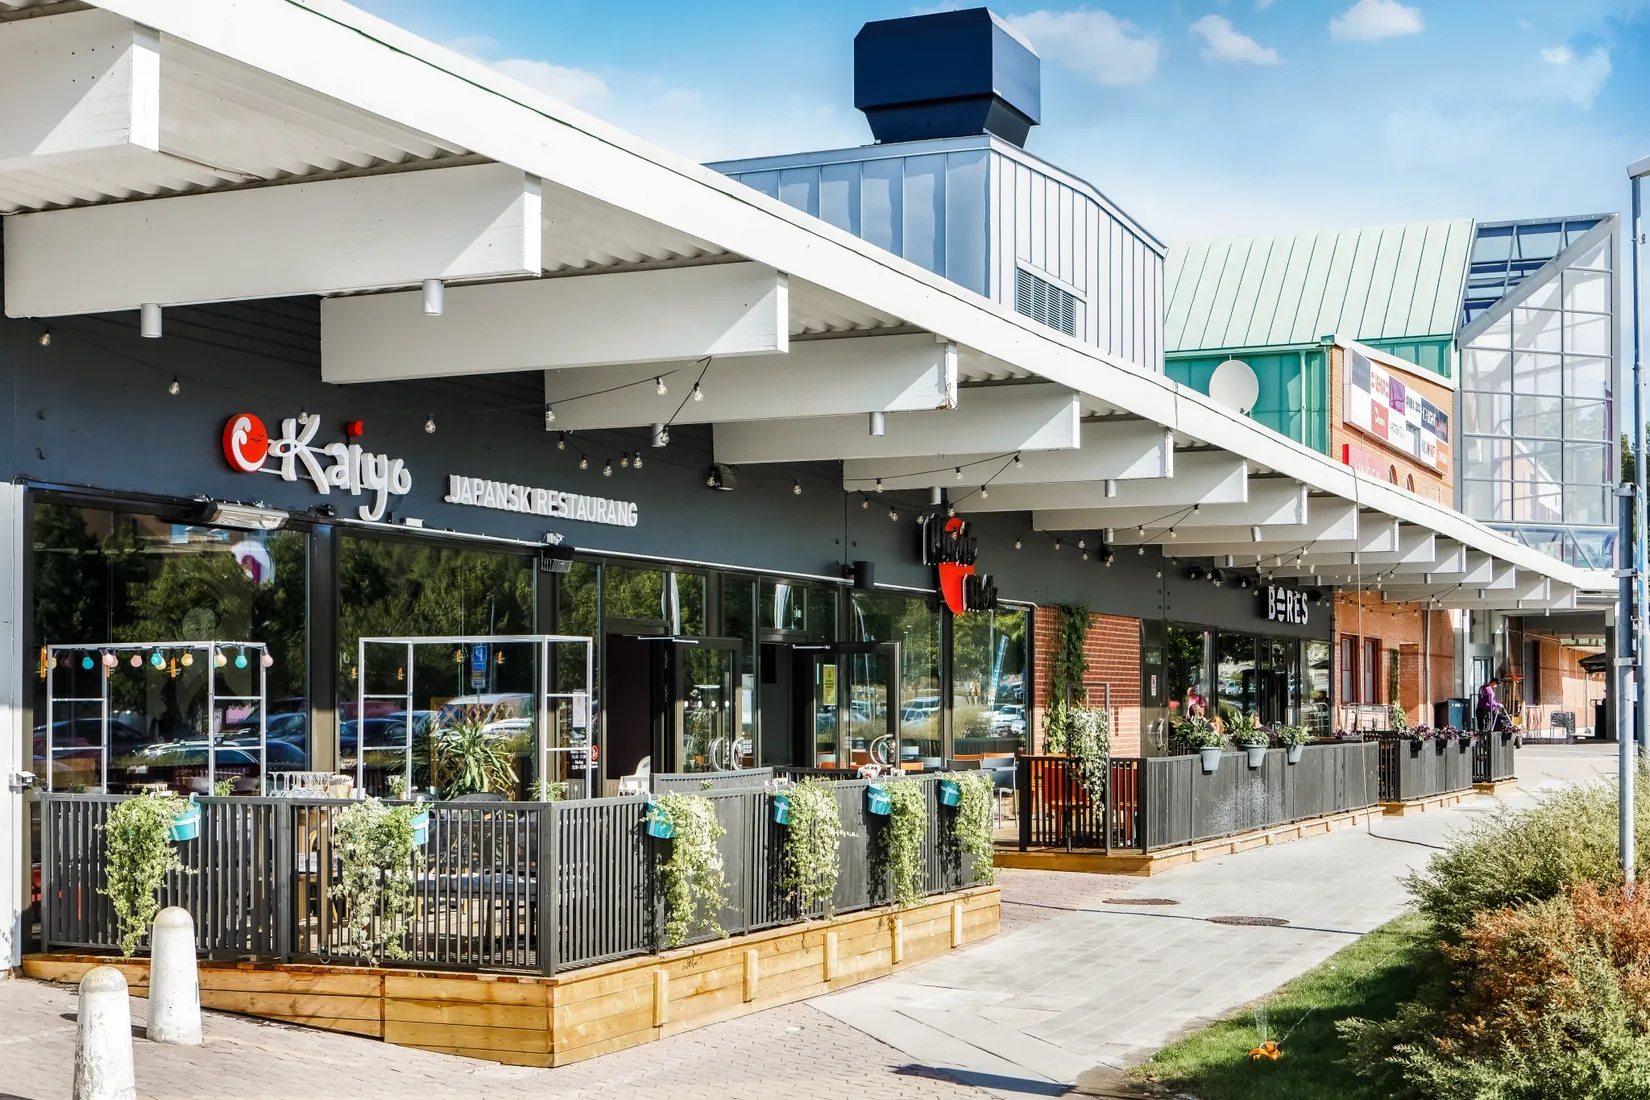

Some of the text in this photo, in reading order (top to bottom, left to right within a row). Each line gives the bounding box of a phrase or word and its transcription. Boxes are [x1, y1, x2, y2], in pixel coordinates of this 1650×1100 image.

[268, 414, 412, 521] Kaiyo
[445, 474, 638, 527] JAPANSK RESTAURANG
